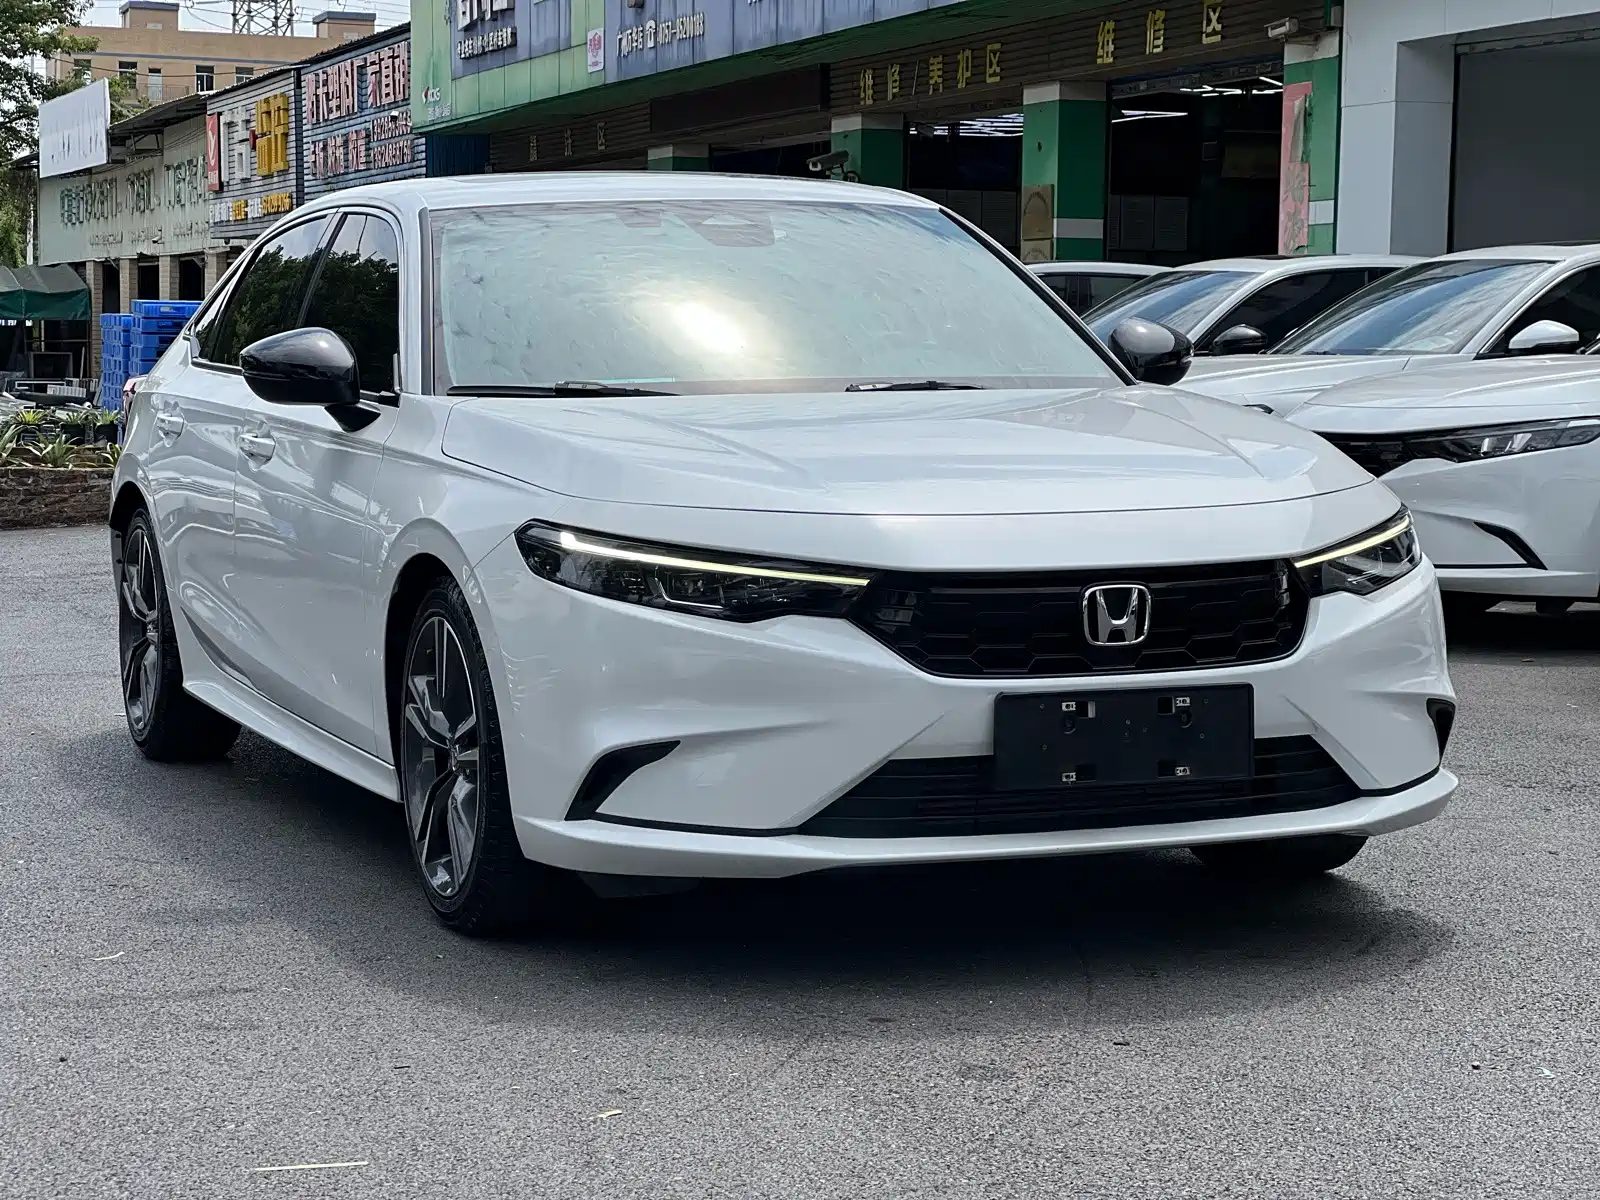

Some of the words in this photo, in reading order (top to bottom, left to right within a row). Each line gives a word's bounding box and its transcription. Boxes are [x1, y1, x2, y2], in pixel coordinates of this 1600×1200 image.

[1096, 0, 1222, 64] 维修区
[860, 42, 1001, 106] 维修/养护区
[1095, 586, 1139, 644] H
